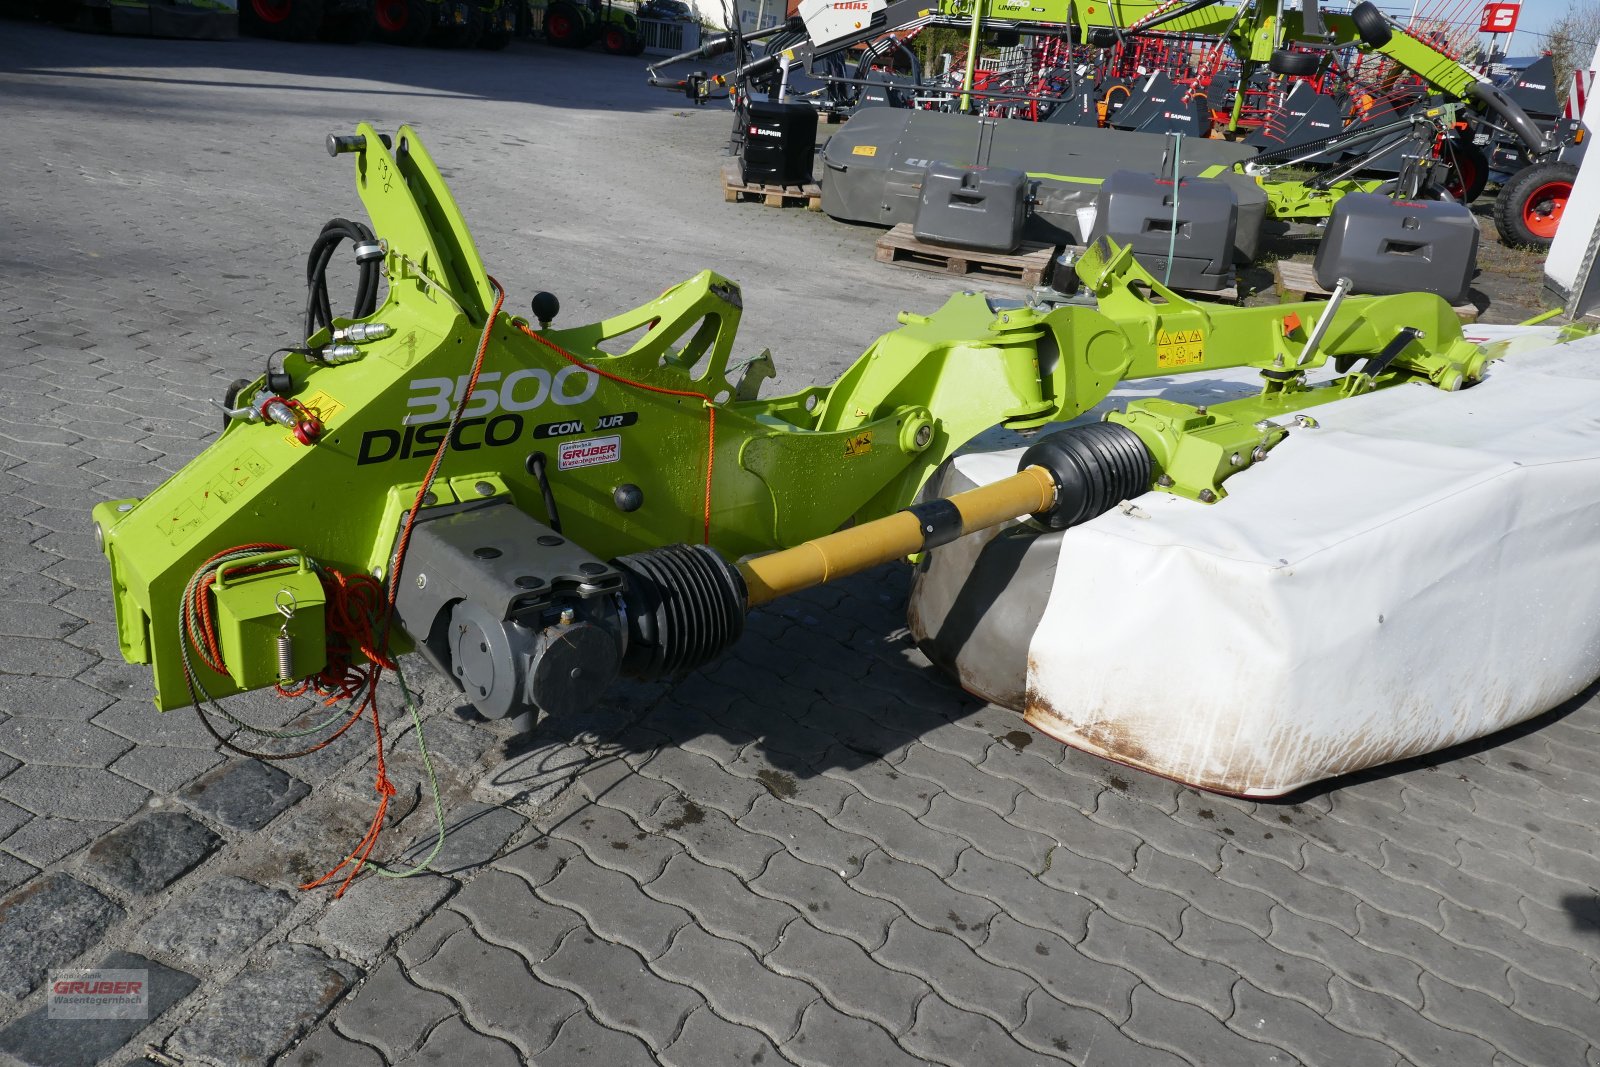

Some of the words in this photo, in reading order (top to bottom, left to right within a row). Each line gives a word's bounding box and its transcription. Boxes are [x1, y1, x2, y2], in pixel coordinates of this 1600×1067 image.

[833, 2, 868, 10] CLAAS
[1170, 113, 1192, 122] SAPHIR
[757, 128, 782, 138] SAPHIR
[402, 364, 600, 426] 3500
[357, 413, 524, 466] DISCO
[562, 443, 617, 460] GRUBER
[562, 453, 617, 467] Wasentegernbach
